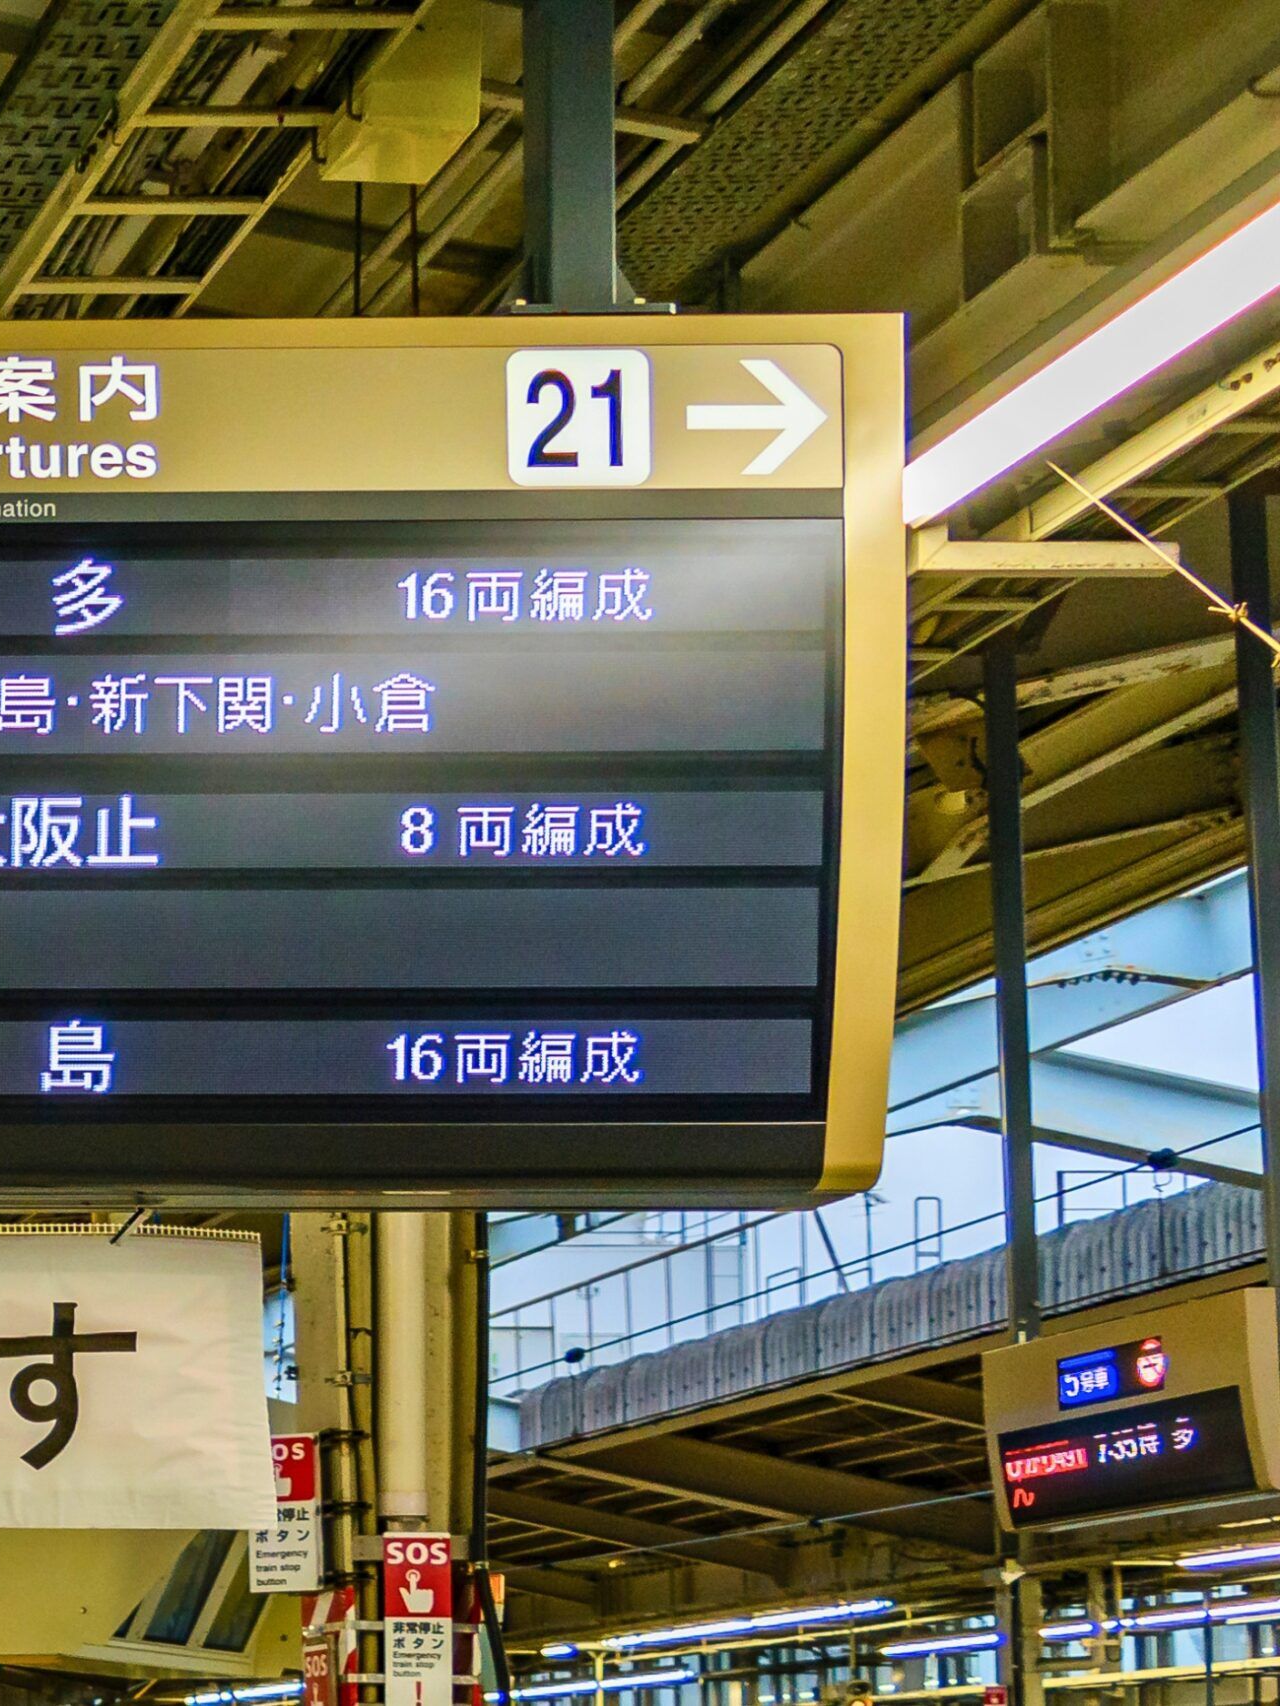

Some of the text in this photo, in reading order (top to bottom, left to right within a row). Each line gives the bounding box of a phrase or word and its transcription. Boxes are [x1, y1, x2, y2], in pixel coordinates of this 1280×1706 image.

[525, 368, 624, 468] 21
[272, 1442, 305, 1461] OS
[386, 1542, 448, 1565] SOS
